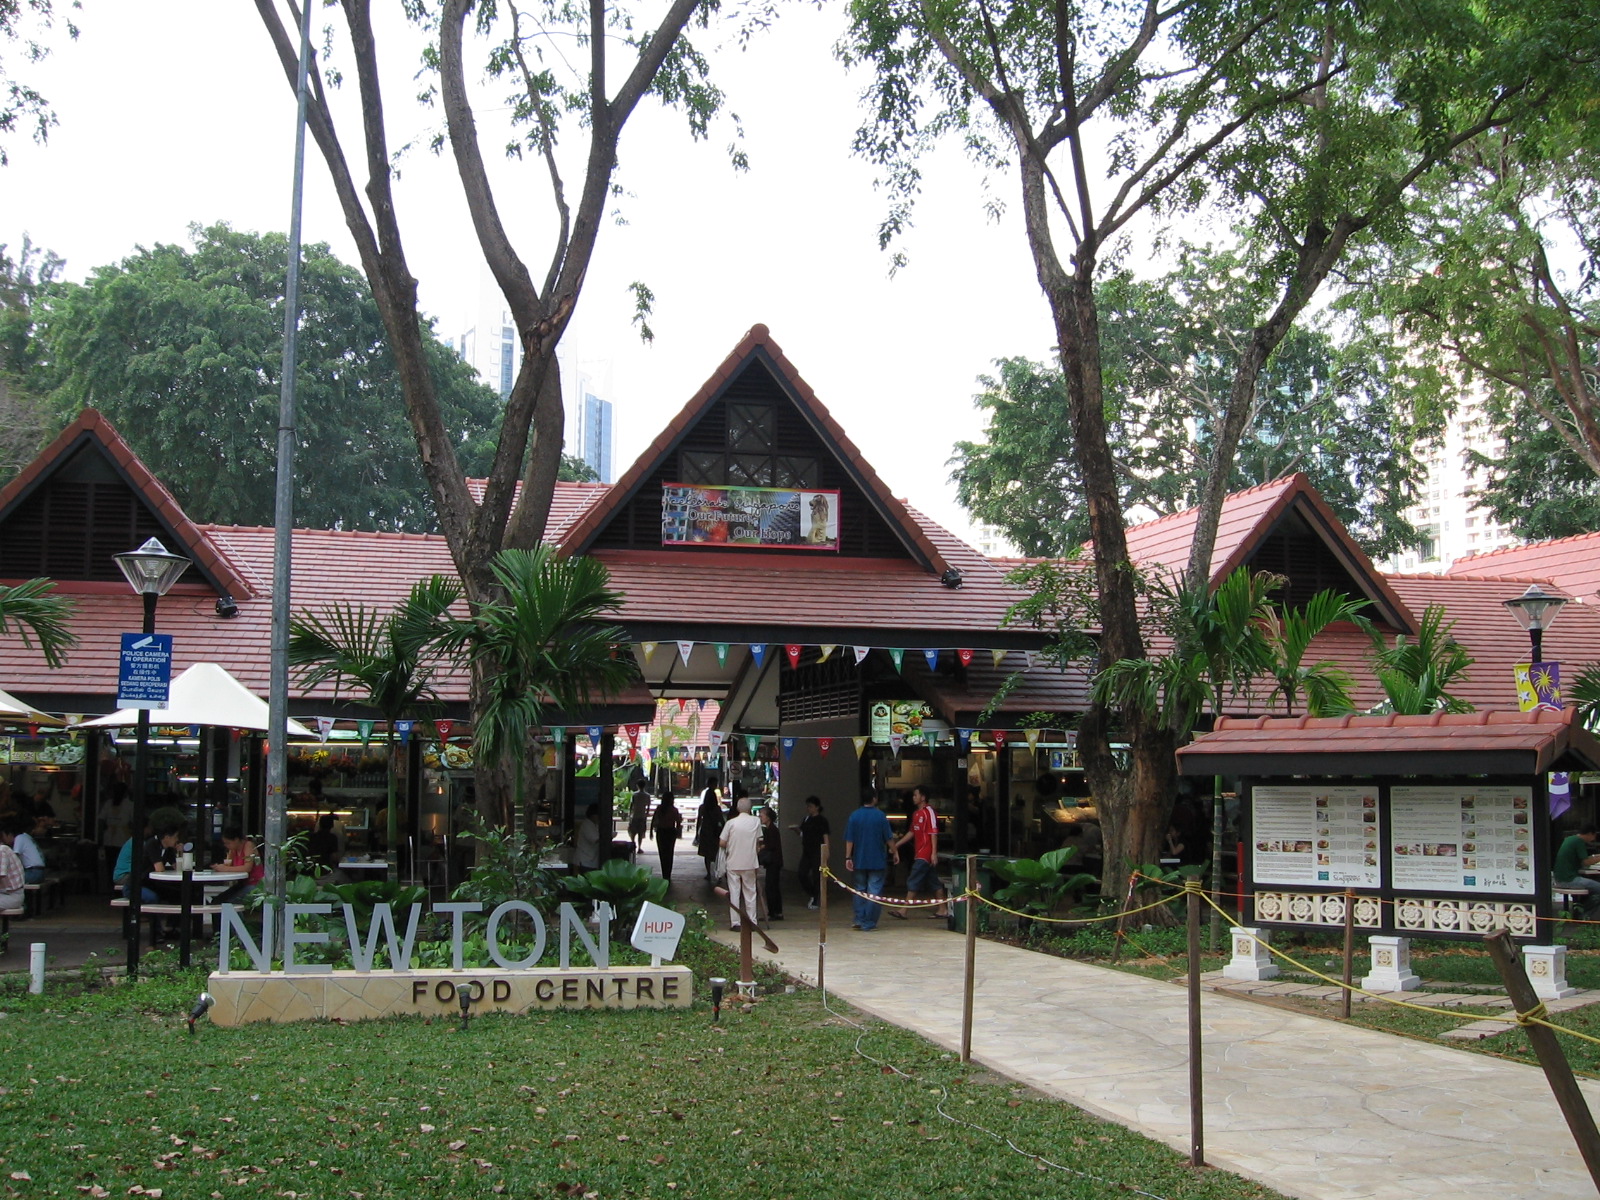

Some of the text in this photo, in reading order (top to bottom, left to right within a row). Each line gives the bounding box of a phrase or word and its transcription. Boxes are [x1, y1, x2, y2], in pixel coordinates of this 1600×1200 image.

[688, 509, 711, 522] Our
[733, 526, 792, 542] Our Hope
[644, 921, 673, 933] HUP
[219, 900, 609, 975] NEWTON
[412, 976, 679, 1004] FOOD CENTRE
